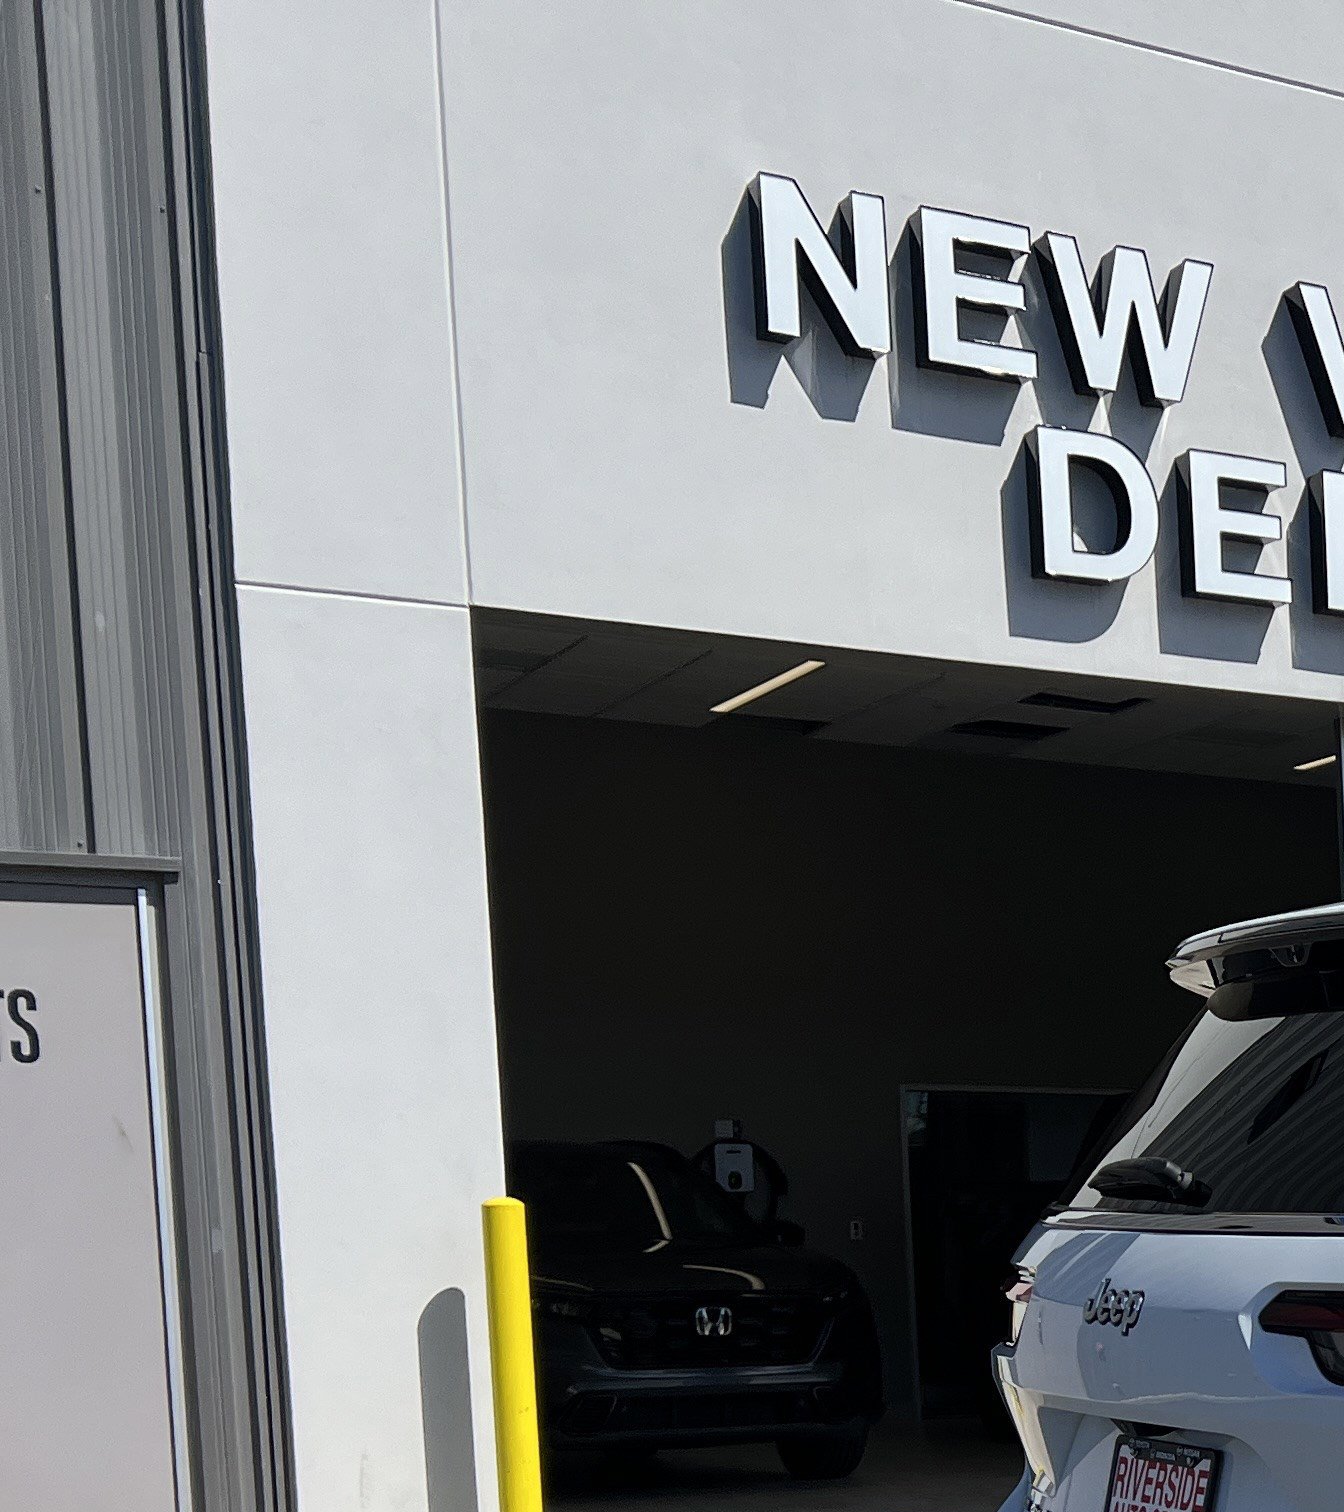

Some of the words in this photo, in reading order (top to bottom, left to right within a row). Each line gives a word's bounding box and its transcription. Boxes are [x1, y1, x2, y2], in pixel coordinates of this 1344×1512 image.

[754, 172, 1214, 404] NEW
[0, 988, 40, 1064] S
[1083, 1278, 1145, 1336] Jeep
